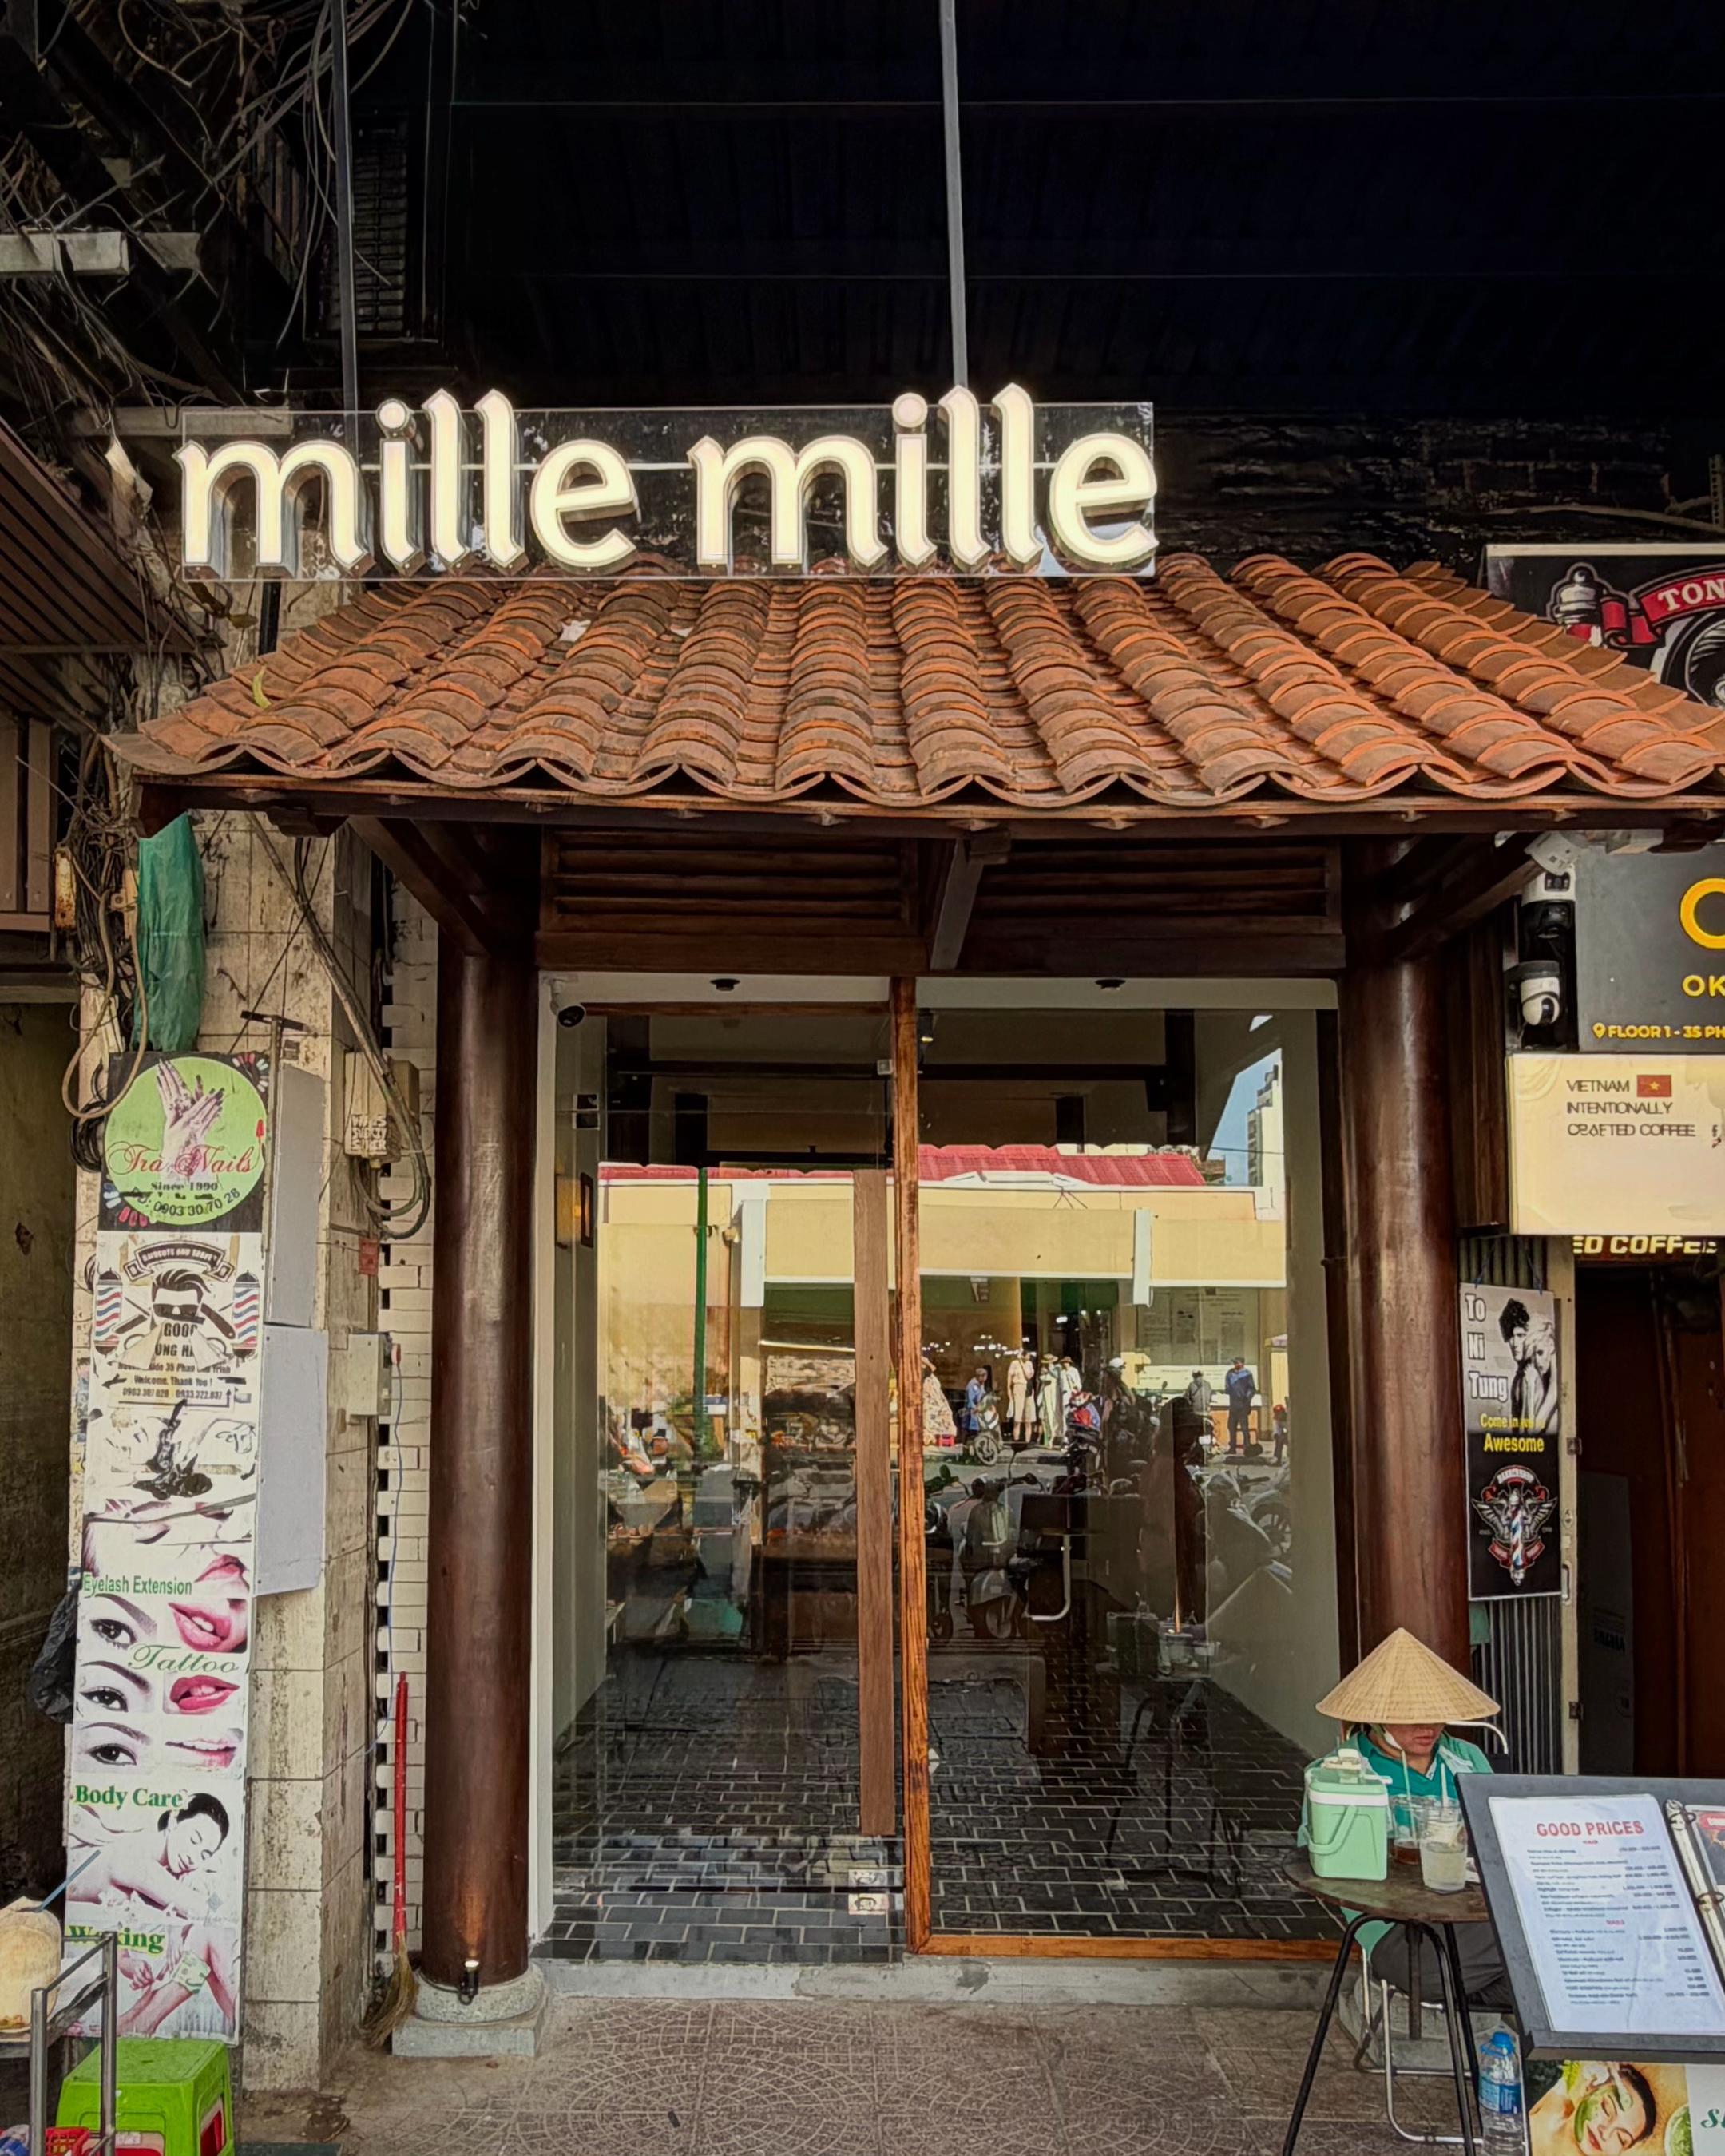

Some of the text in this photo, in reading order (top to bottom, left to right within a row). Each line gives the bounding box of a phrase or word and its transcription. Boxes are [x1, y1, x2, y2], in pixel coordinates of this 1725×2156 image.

[174, 382, 1158, 573] mille mille
[1608, 1024, 1661, 1038] FLOOR
[1566, 1080, 1630, 1092] VIETNAM
[1566, 1101, 1673, 1115] INTENTIONALLY
[1639, 1123, 1696, 1137] COFFEE
[150, 1181, 219, 1191] Since 1990
[153, 1201, 184, 1217] 0903
[187, 1204, 204, 1216] 30
[207, 1199, 223, 1212] 70
[224, 1187, 240, 1204] 28
[1465, 1293, 1486, 1322] To
[1467, 1331, 1485, 1360] Ni
[170, 1376, 192, 1386] Thank
[1468, 1370, 1508, 1403] Tung
[1480, 1413, 1508, 1428] Come
[1484, 1433, 1545, 1453] Awesome
[82, 1574, 192, 1597] Eyelash Extension
[128, 1643, 239, 1674] Tattoo
[74, 1785, 184, 1811] Body Care
[1537, 1820, 1644, 1837] GOOD PRICES
[69, 1924, 165, 1954] Wing
[1700, 2108, 1725, 2129] S
